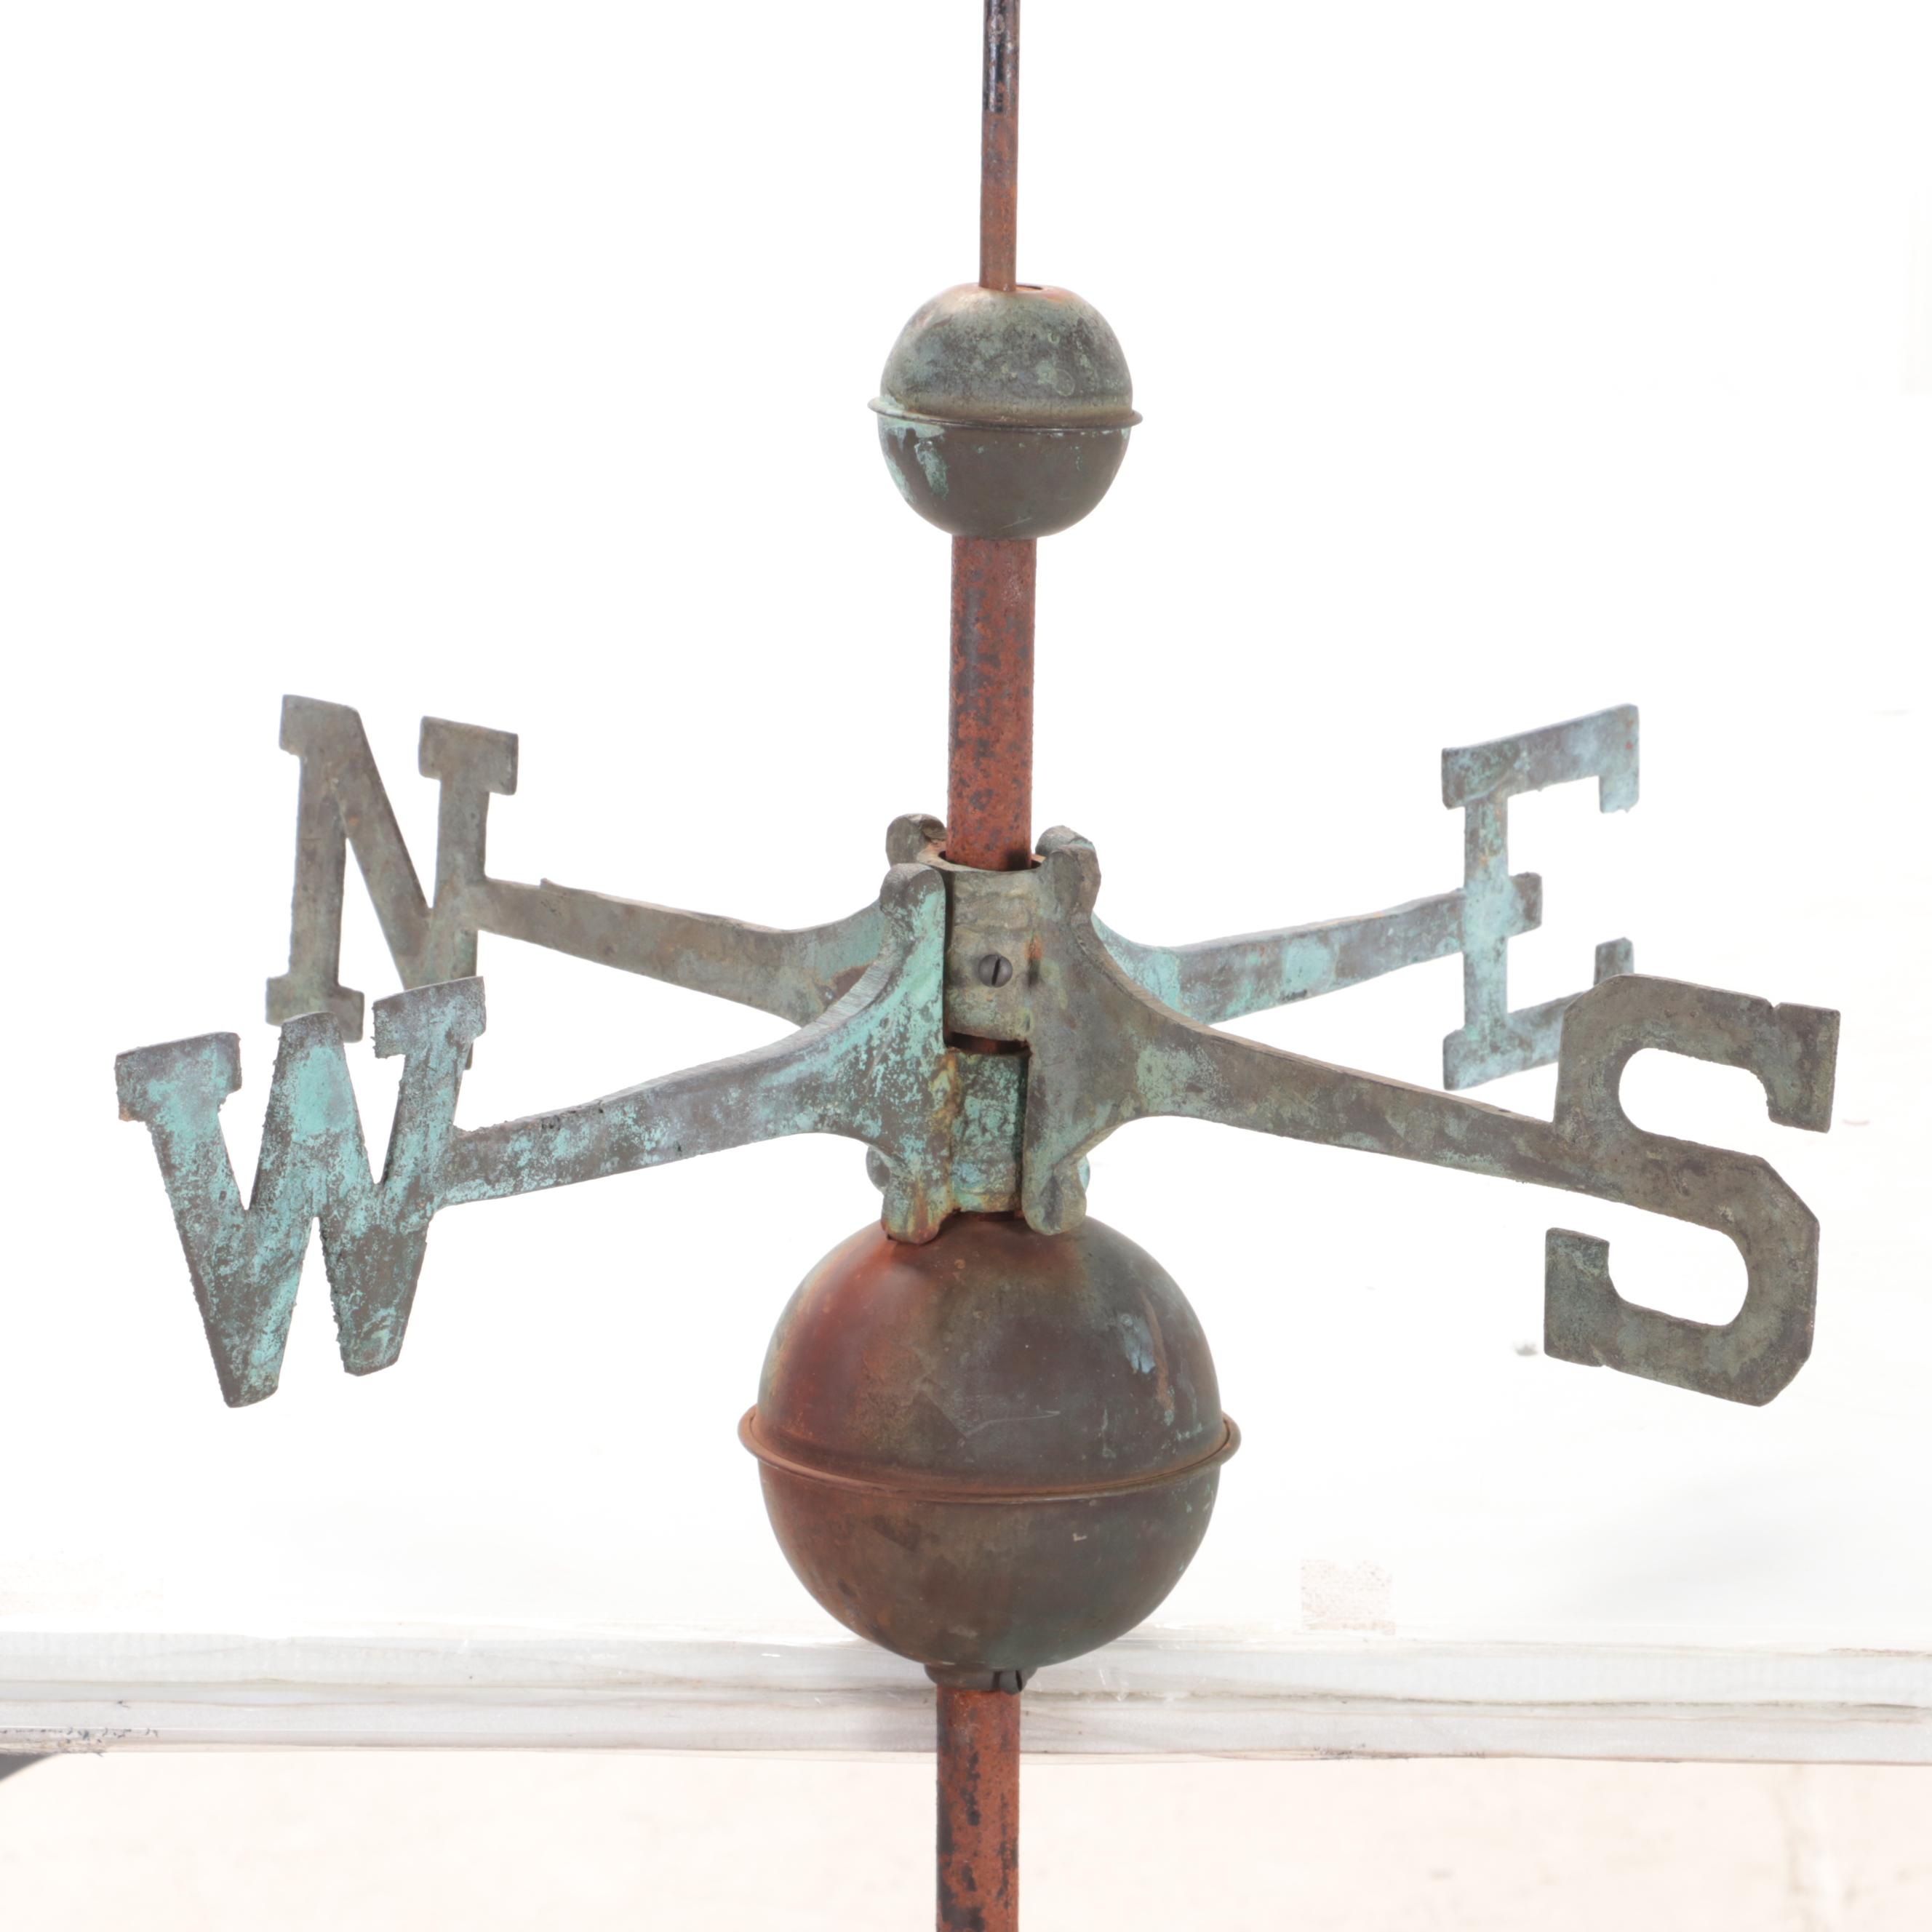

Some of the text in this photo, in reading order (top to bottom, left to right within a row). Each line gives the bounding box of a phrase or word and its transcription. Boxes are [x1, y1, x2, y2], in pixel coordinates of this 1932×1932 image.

[266, 694, 519, 1069] N
[1442, 703, 1639, 1090] E
[115, 976, 487, 1408] W
[1544, 973, 1840, 1407] S
